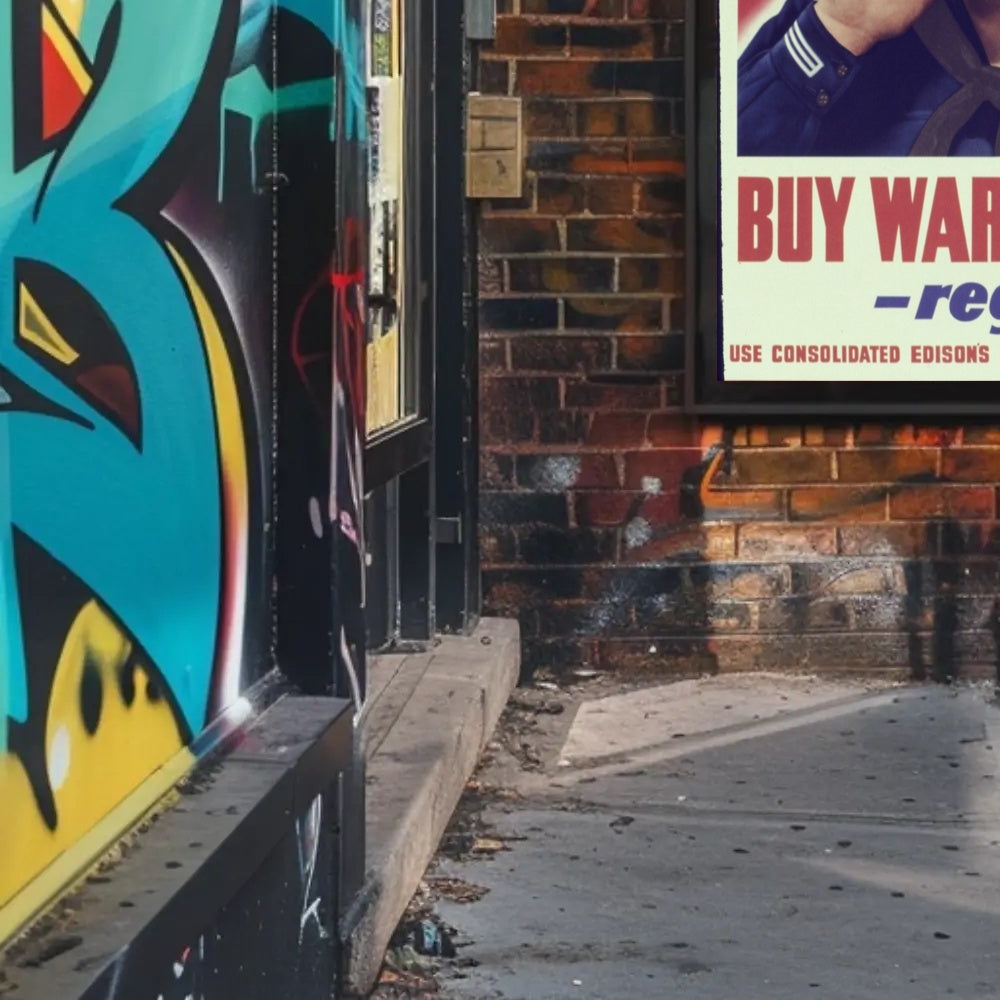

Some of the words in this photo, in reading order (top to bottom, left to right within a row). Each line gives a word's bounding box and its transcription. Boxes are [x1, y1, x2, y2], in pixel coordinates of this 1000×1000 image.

[737, 176, 855, 262] BUY
[729, 345, 762, 363] USE
[771, 345, 901, 364] CONSOLIDATED
